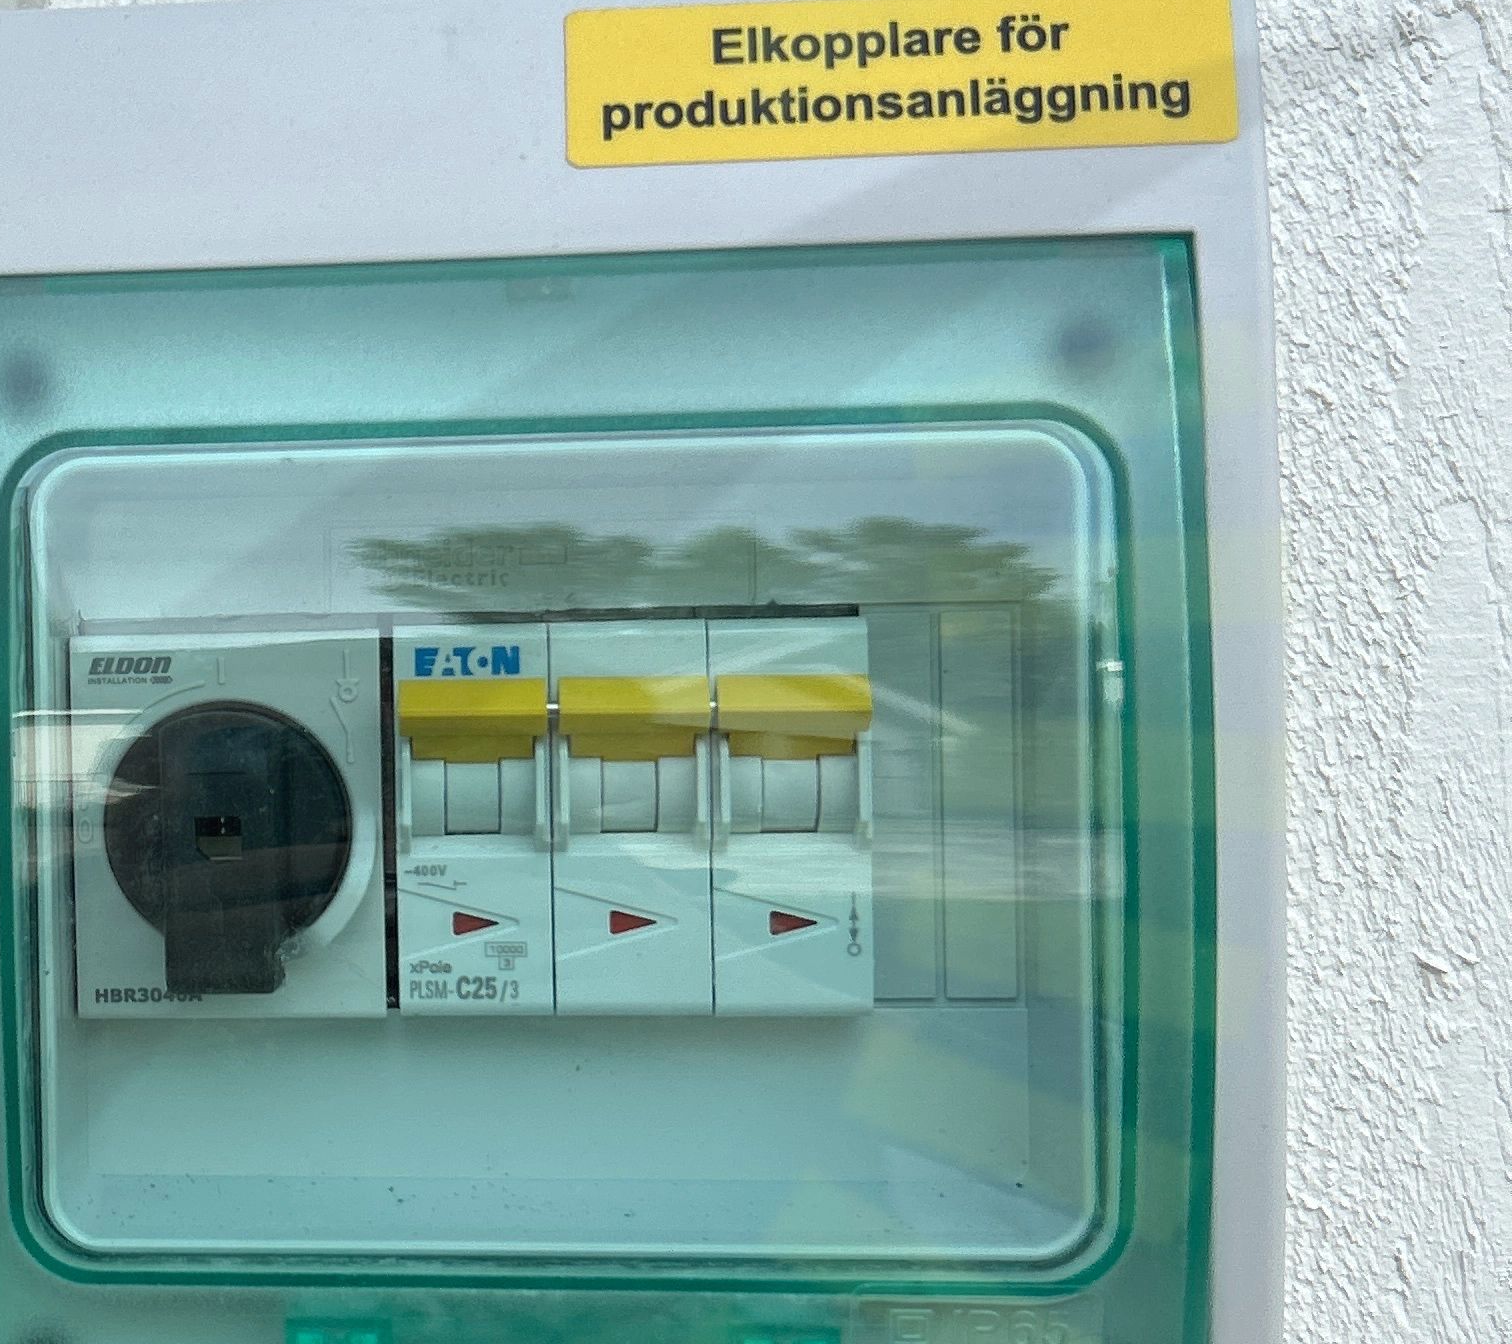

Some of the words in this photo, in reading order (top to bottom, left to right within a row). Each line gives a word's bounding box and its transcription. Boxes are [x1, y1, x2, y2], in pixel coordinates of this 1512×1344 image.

[711, 21, 981, 70] Elkopplare
[998, 15, 1069, 53] för
[601, 73, 1190, 141] produktionsanläggning
[88, 656, 172, 675] ELDON
[414, 646, 520, 677] EATON
[88, 675, 148, 685] INSTALLATION
[409, 959, 453, 974] xPole
